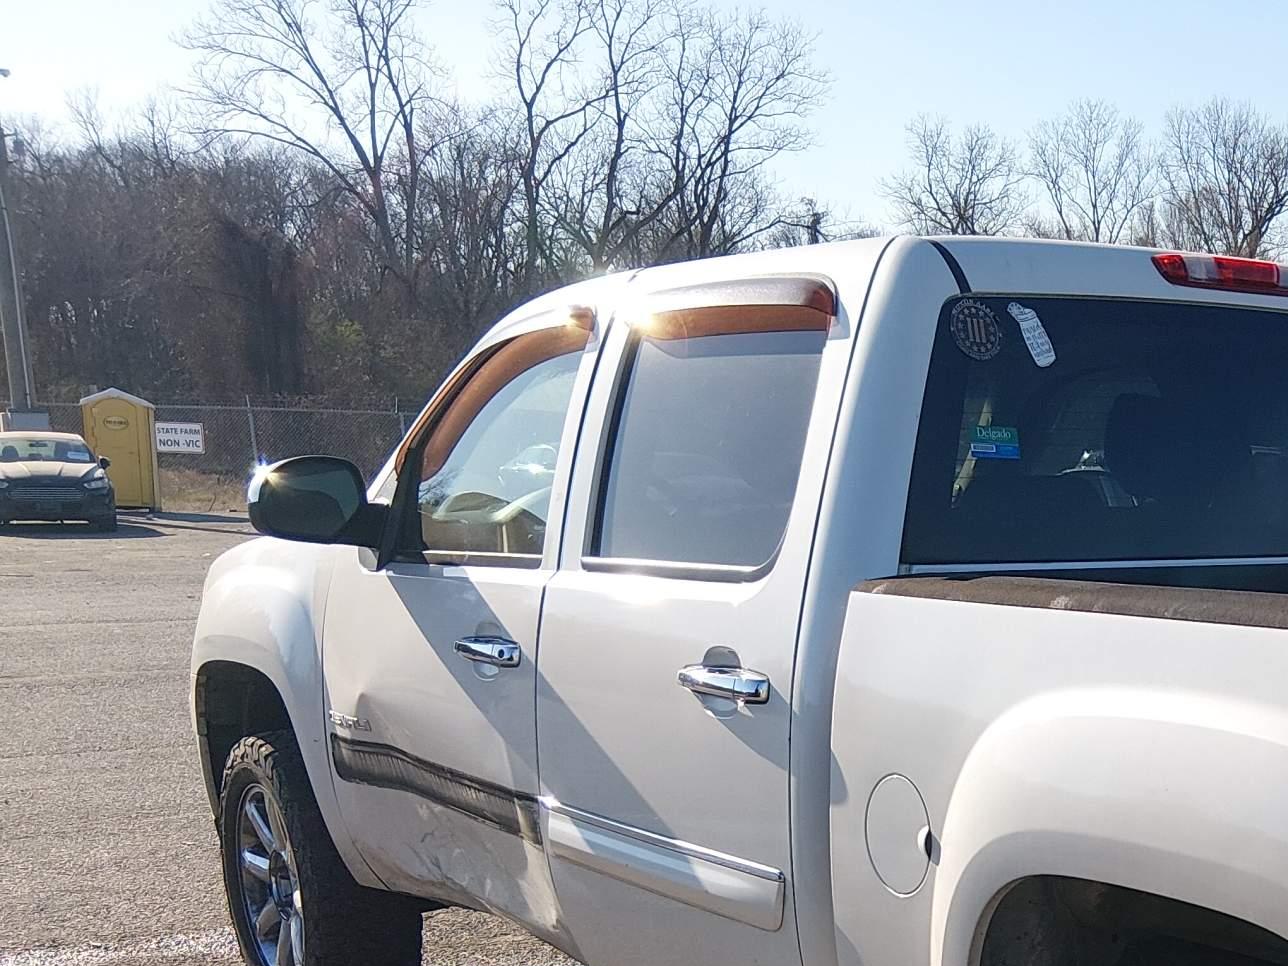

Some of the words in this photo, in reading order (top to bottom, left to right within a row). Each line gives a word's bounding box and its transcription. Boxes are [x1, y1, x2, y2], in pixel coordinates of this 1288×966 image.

[157, 427, 178, 435] STATE
[180, 428, 201, 436] FARM
[976, 426, 1011, 441] Delgado
[159, 439, 180, 447] NON
